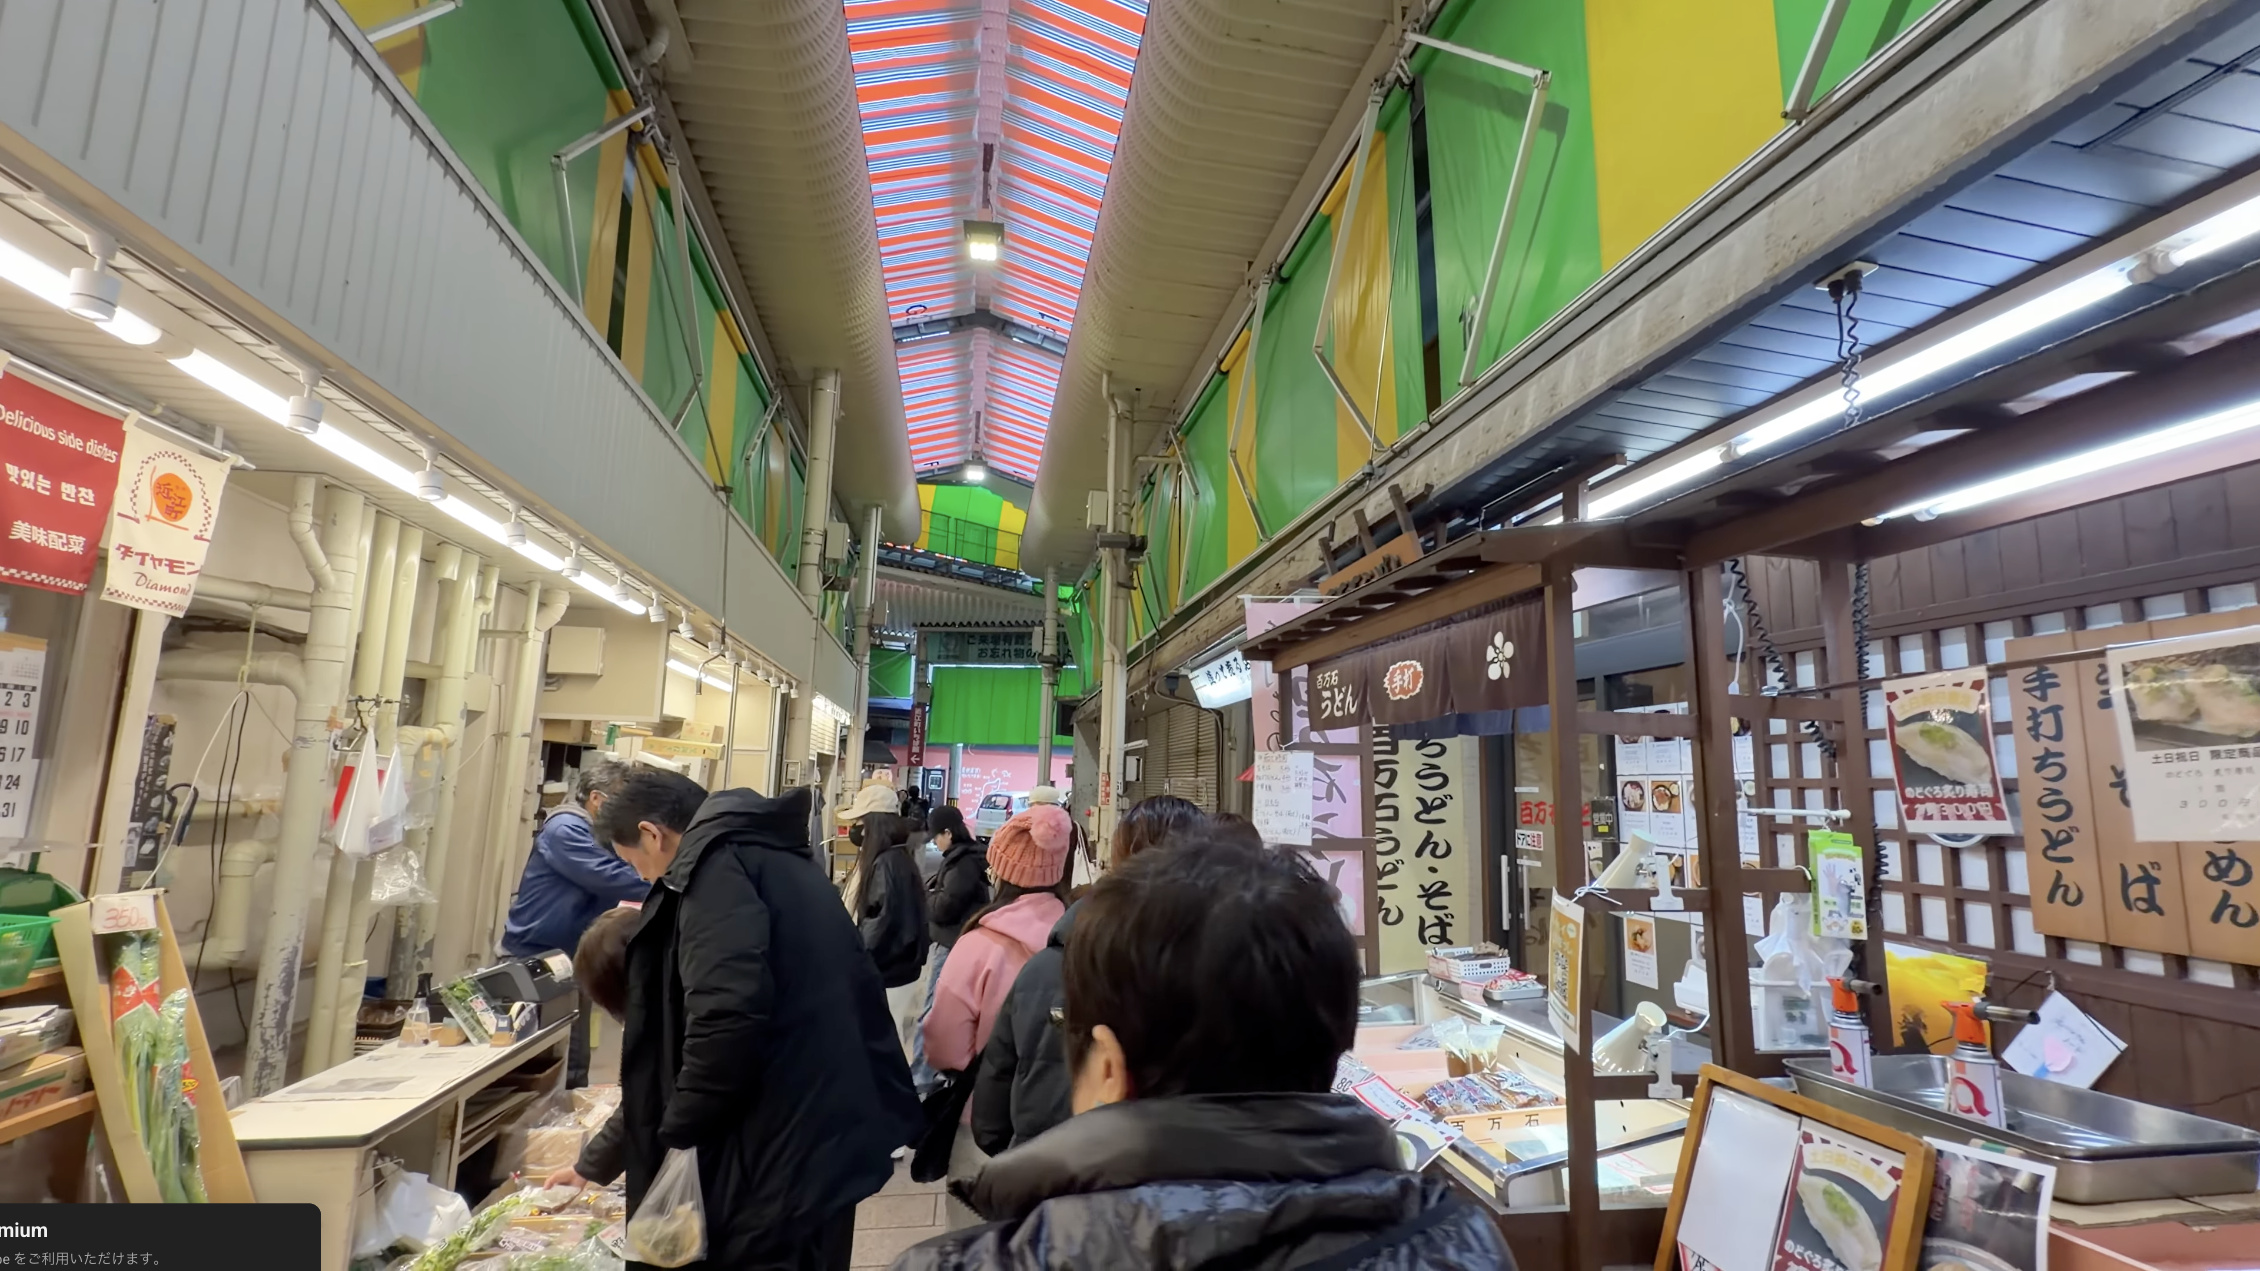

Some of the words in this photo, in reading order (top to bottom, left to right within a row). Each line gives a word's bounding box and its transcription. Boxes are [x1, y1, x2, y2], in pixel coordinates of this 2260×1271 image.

[58, 430, 84, 452] side
[86, 439, 119, 464] dishes
[9, 520, 86, 555] 美味配菜
[1316, 669, 1339, 689] 百万石
[1391, 666, 1415, 694] 手打
[4, 691, 13, 706] 2
[22, 693, 31, 708] 3
[1320, 683, 1358, 719] うどん
[15, 720, 30, 735] 10
[11, 747, 26, 762] 17
[2151, 750, 2200, 765] 土日祝日
[4, 775, 21, 790] 24
[2022, 665, 2084, 908] 手打ちうどん
[1, 802, 16, 818] 31
[1488, 1117, 1502, 1130] 万
